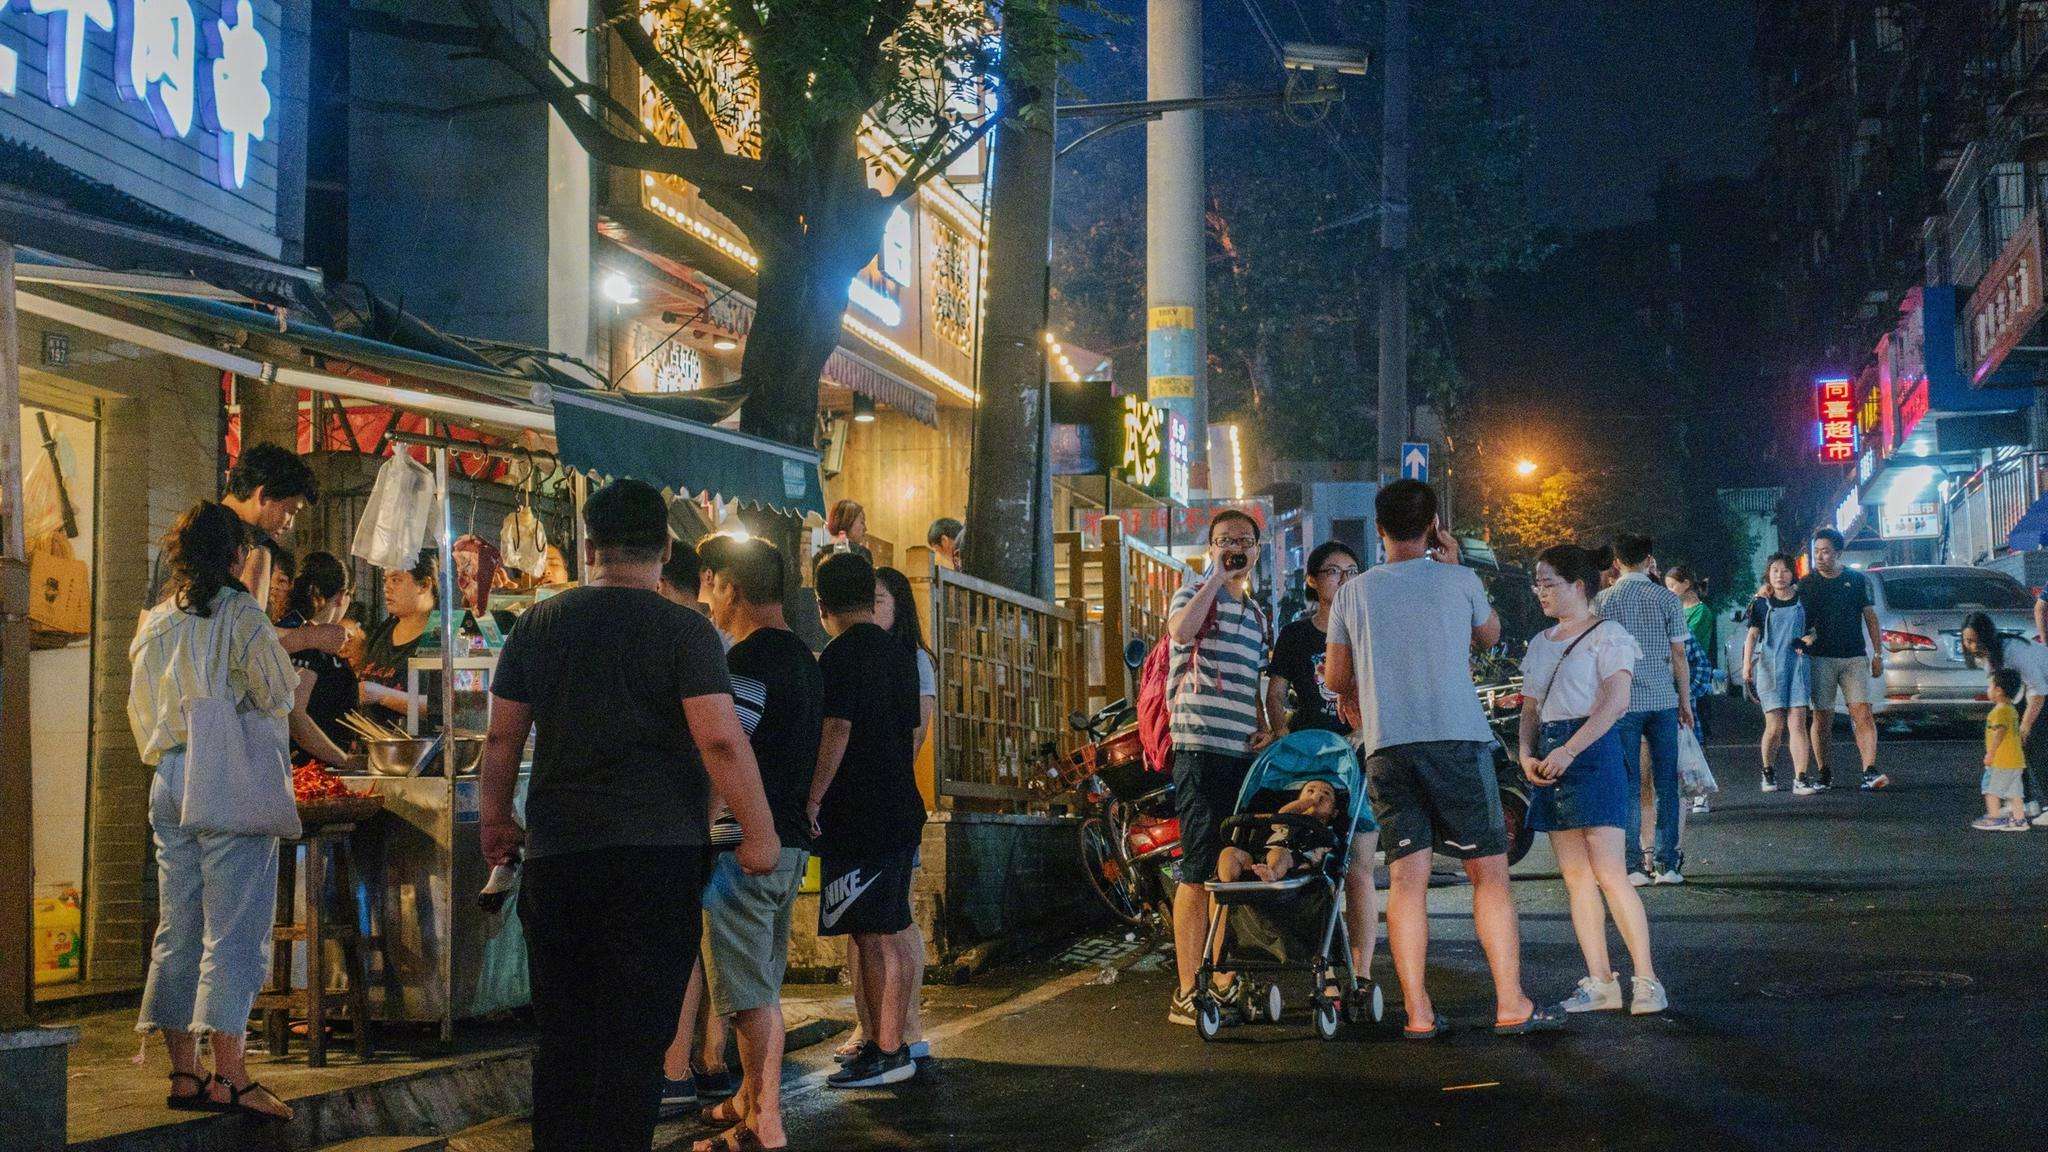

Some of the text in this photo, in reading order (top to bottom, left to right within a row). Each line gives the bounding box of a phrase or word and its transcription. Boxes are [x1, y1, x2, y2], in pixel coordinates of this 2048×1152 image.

[1824, 382, 1853, 459] 同喜超市
[824, 868, 862, 910] NIKE
